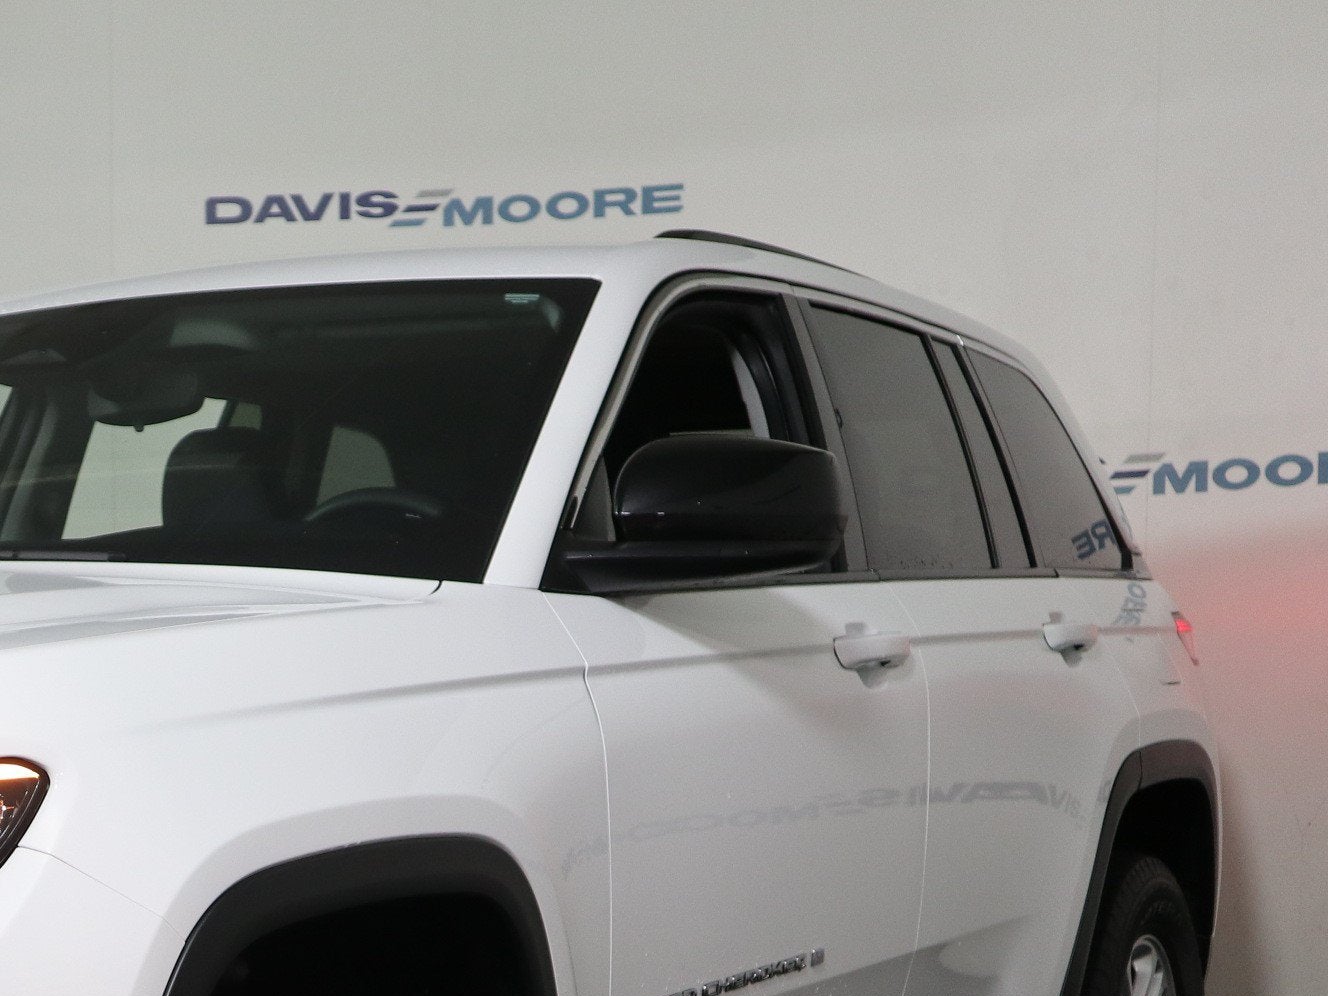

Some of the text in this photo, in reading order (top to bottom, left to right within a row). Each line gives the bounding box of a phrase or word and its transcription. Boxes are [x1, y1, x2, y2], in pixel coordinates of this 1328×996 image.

[204, 183, 685, 227] DAVIS MOORE
[1152, 451, 1328, 496] MOO
